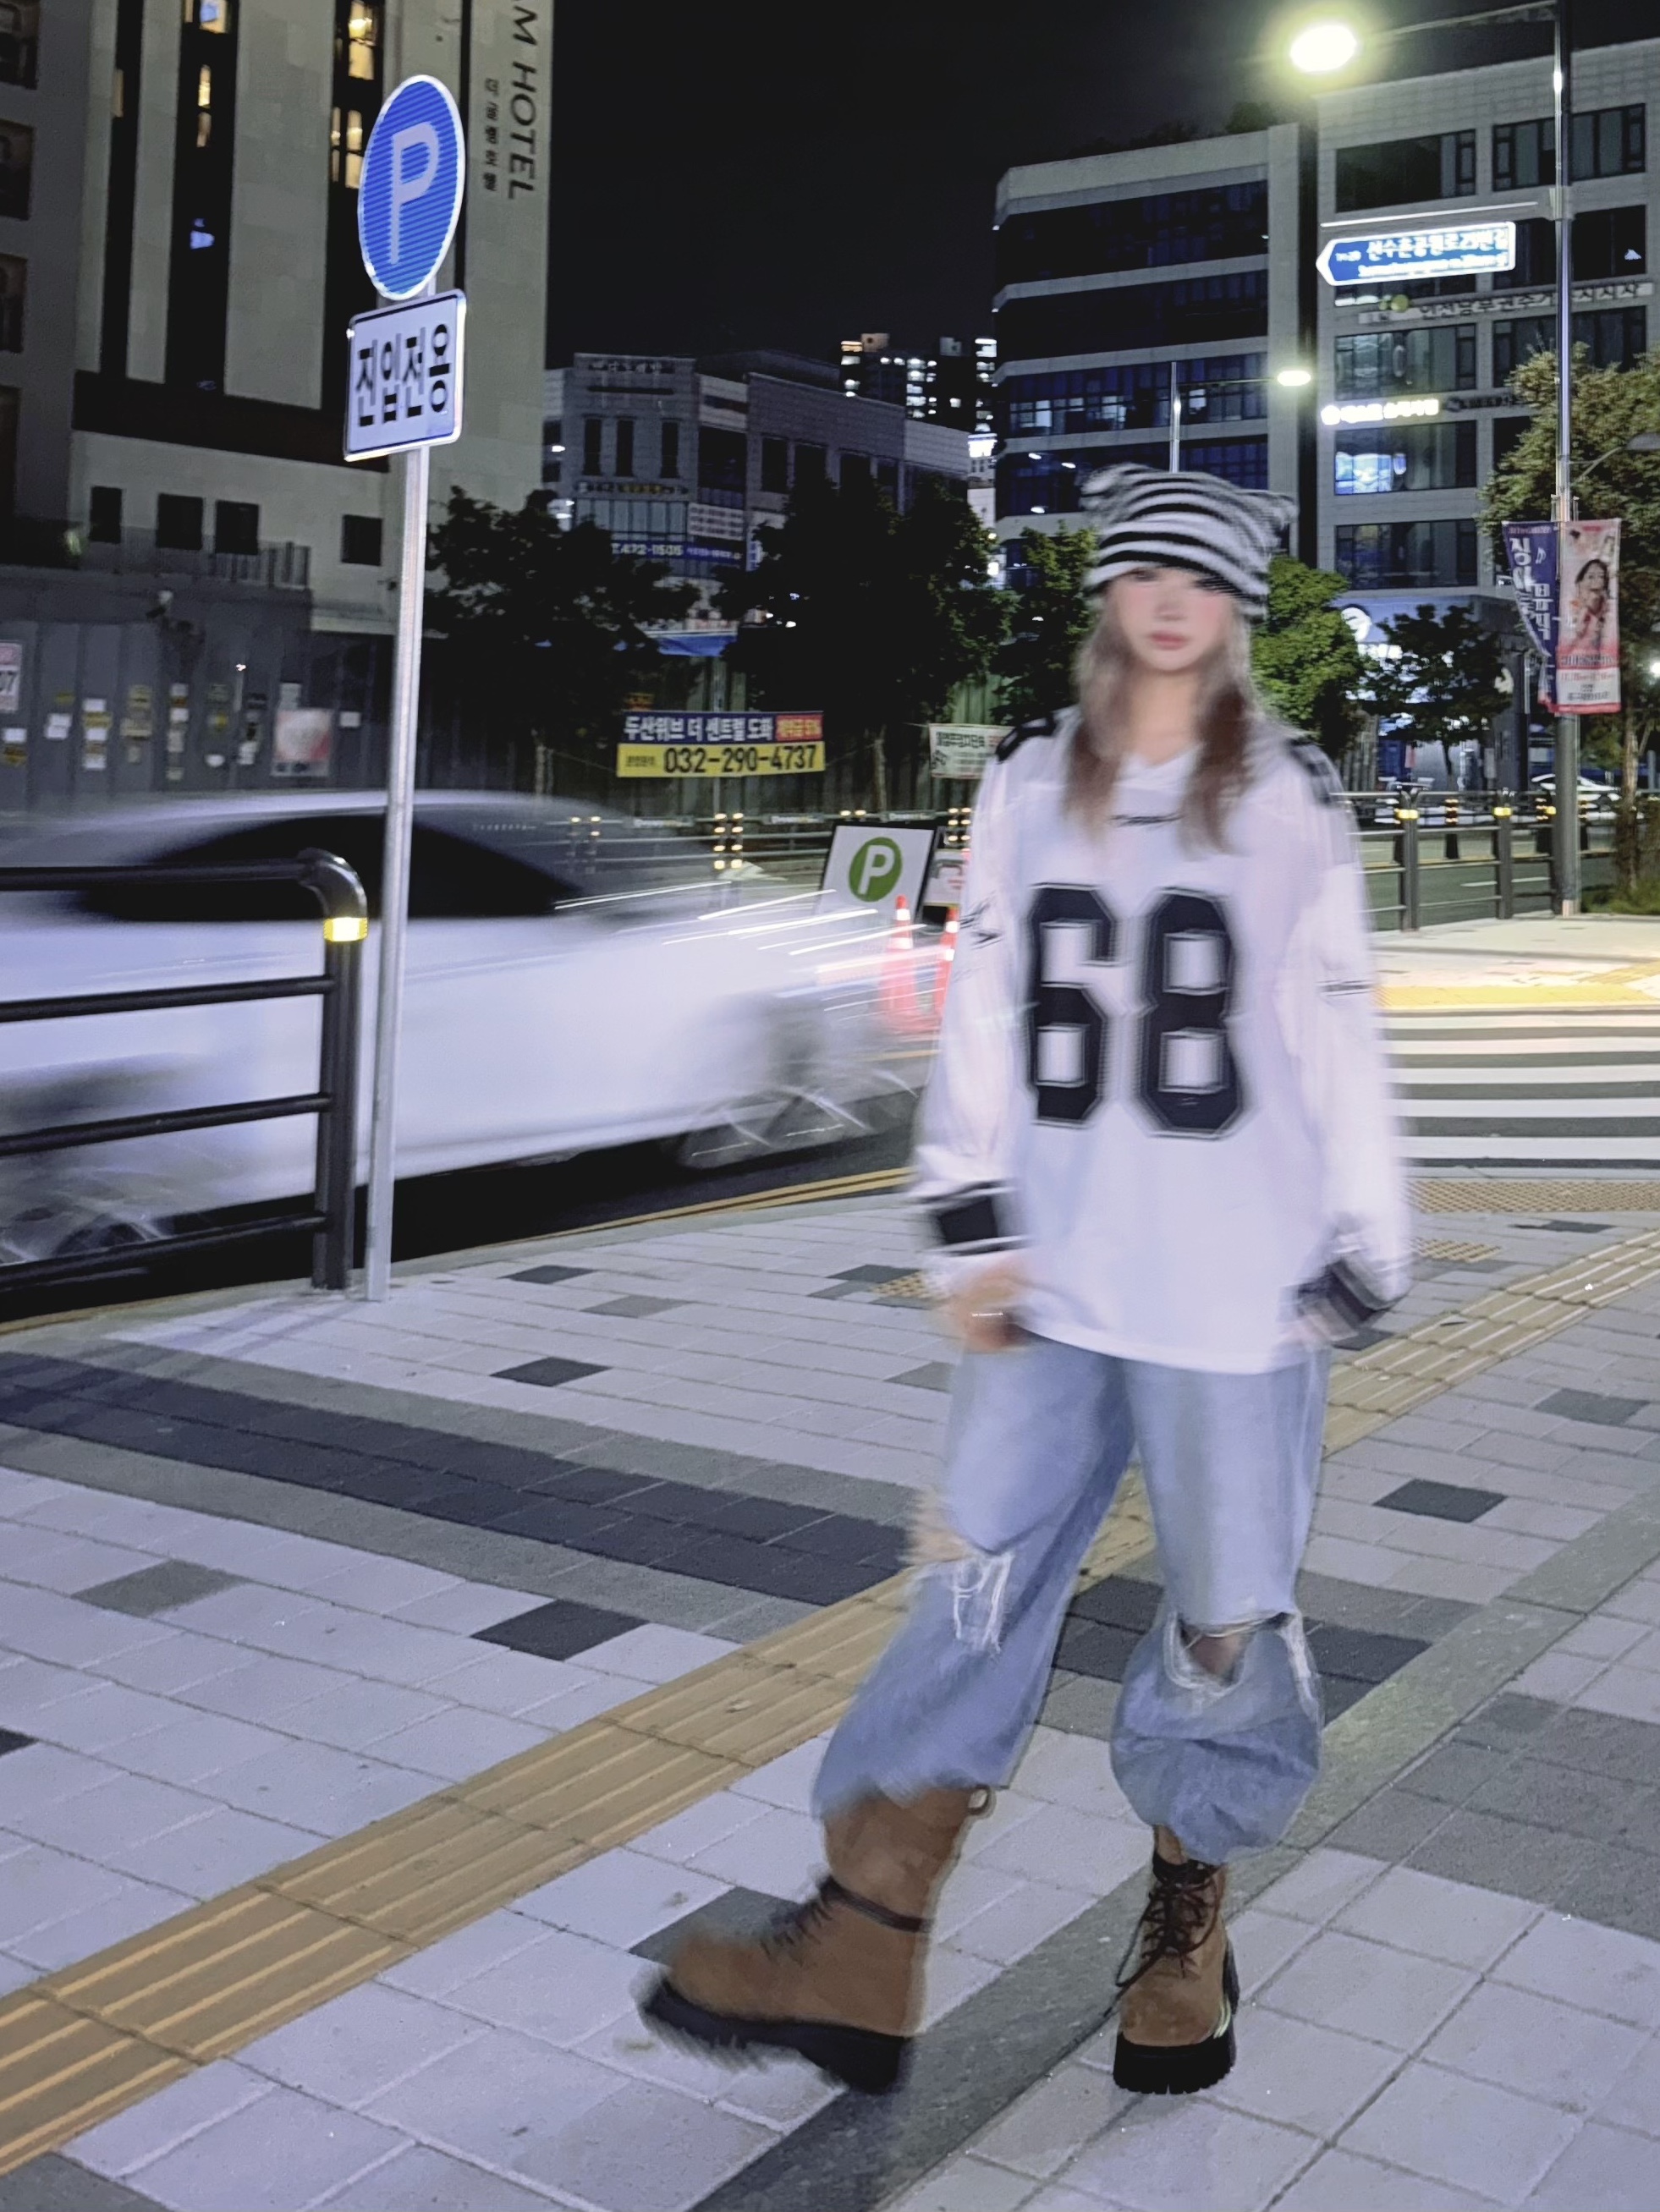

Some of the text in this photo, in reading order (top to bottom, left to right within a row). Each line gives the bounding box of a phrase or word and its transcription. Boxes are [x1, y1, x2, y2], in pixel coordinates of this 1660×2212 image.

[508, 61, 537, 200] HOTEL
[392, 122, 440, 265] P
[356, 324, 450, 427] 진입전용
[624, 716, 684, 741] 두산위브
[687, 716, 703, 742] 더
[705, 716, 746, 742] 센트럴
[747, 716, 773, 741] 도화
[663, 744, 818, 773] 032-290-4737
[860, 845, 895, 895] P
[1021, 882, 1244, 1141] 68
